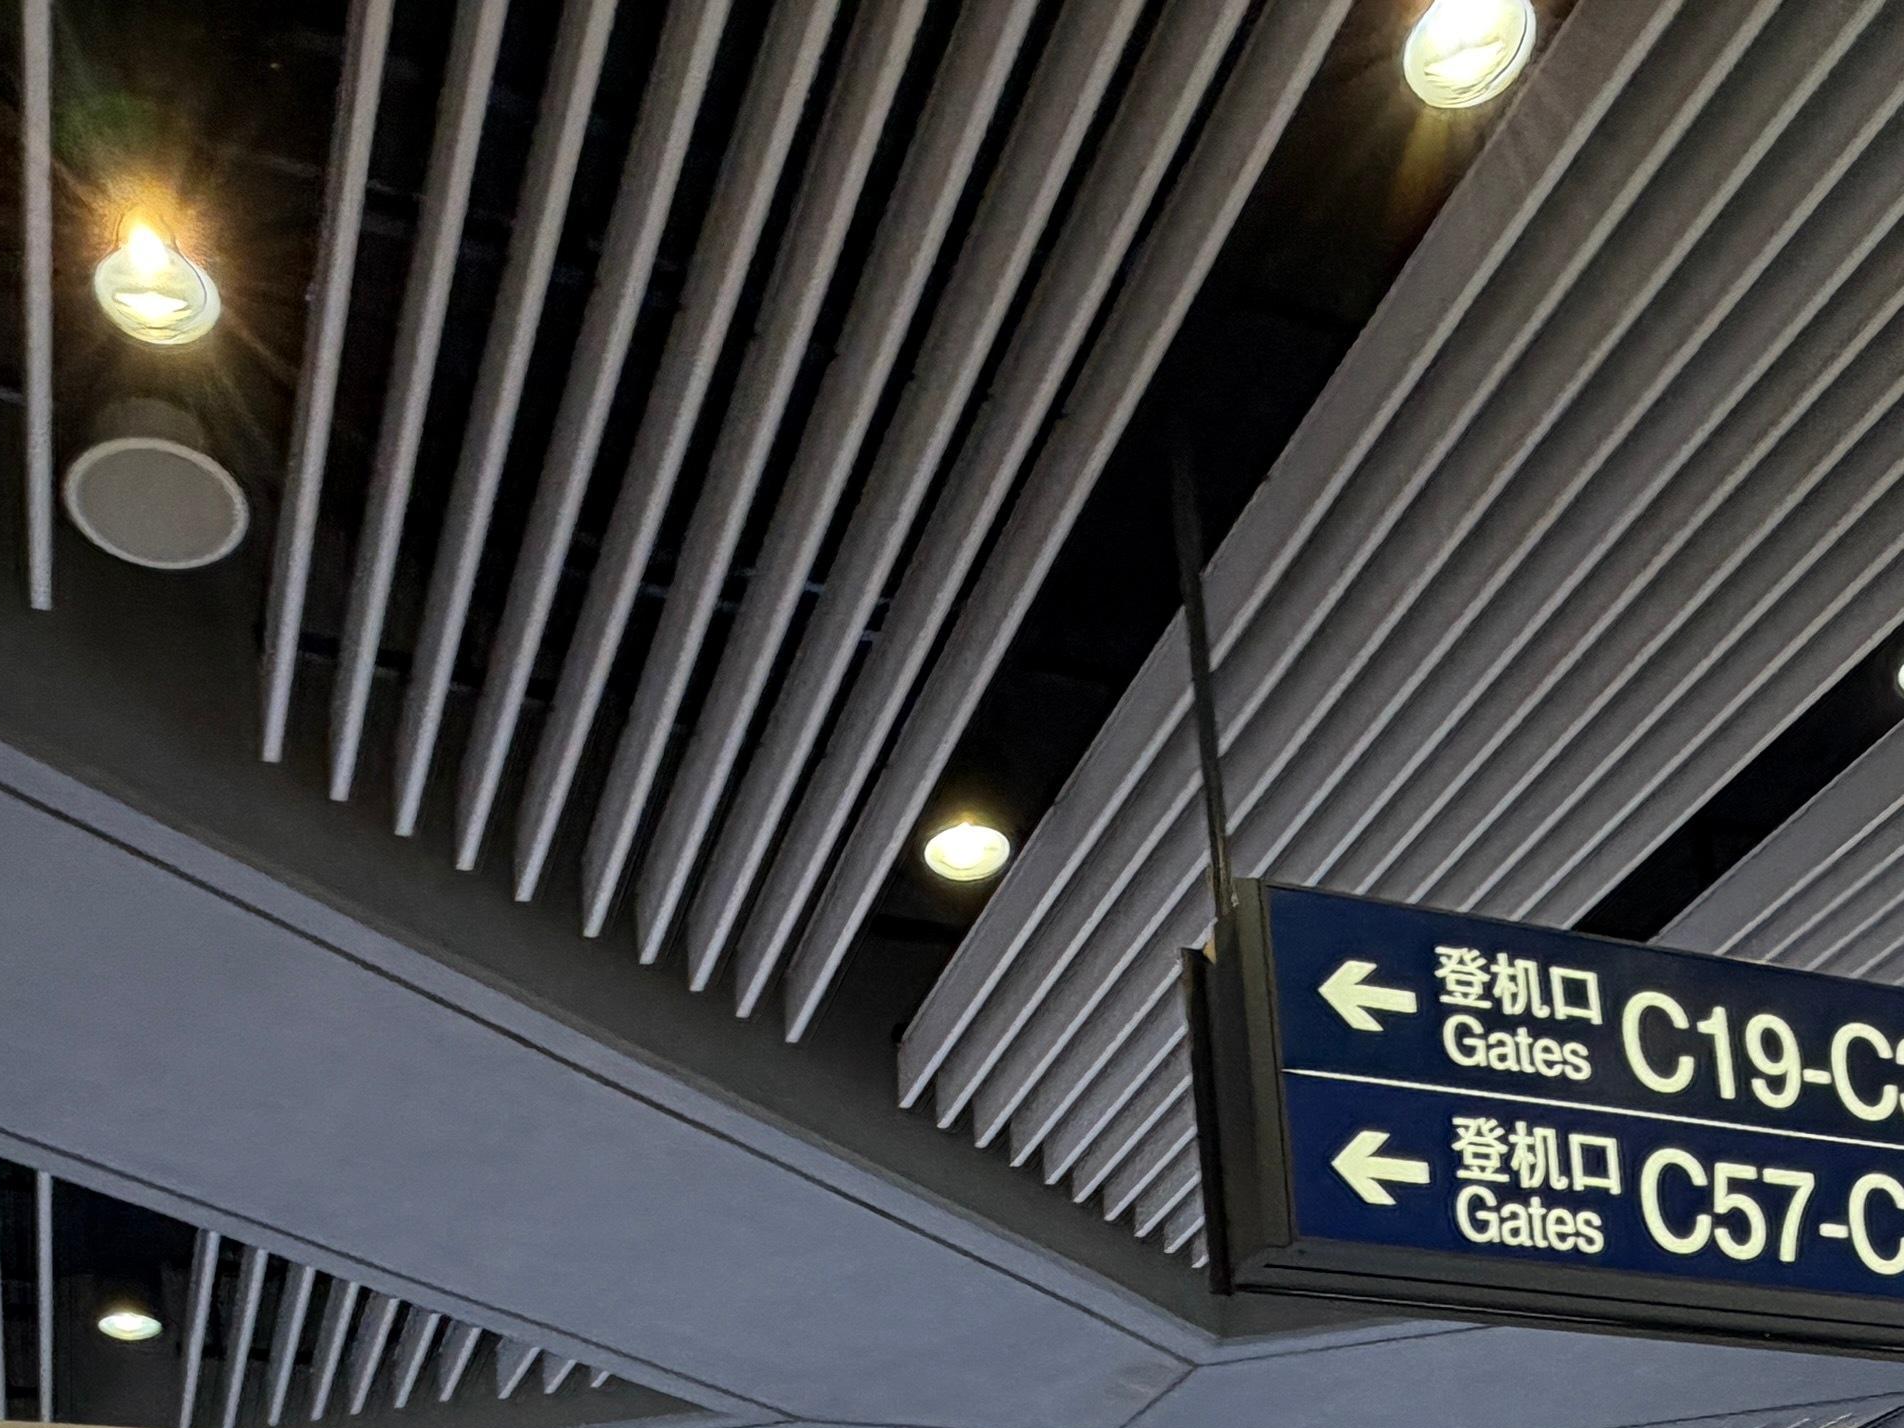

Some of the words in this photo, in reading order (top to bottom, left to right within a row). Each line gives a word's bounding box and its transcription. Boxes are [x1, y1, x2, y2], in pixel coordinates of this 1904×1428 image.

[1434, 945, 1603, 1026] 登机口
[1442, 1014, 1592, 1081] Gates
[1451, 1116, 1622, 1195] 登机口
[1456, 1184, 1605, 1254] Gates
